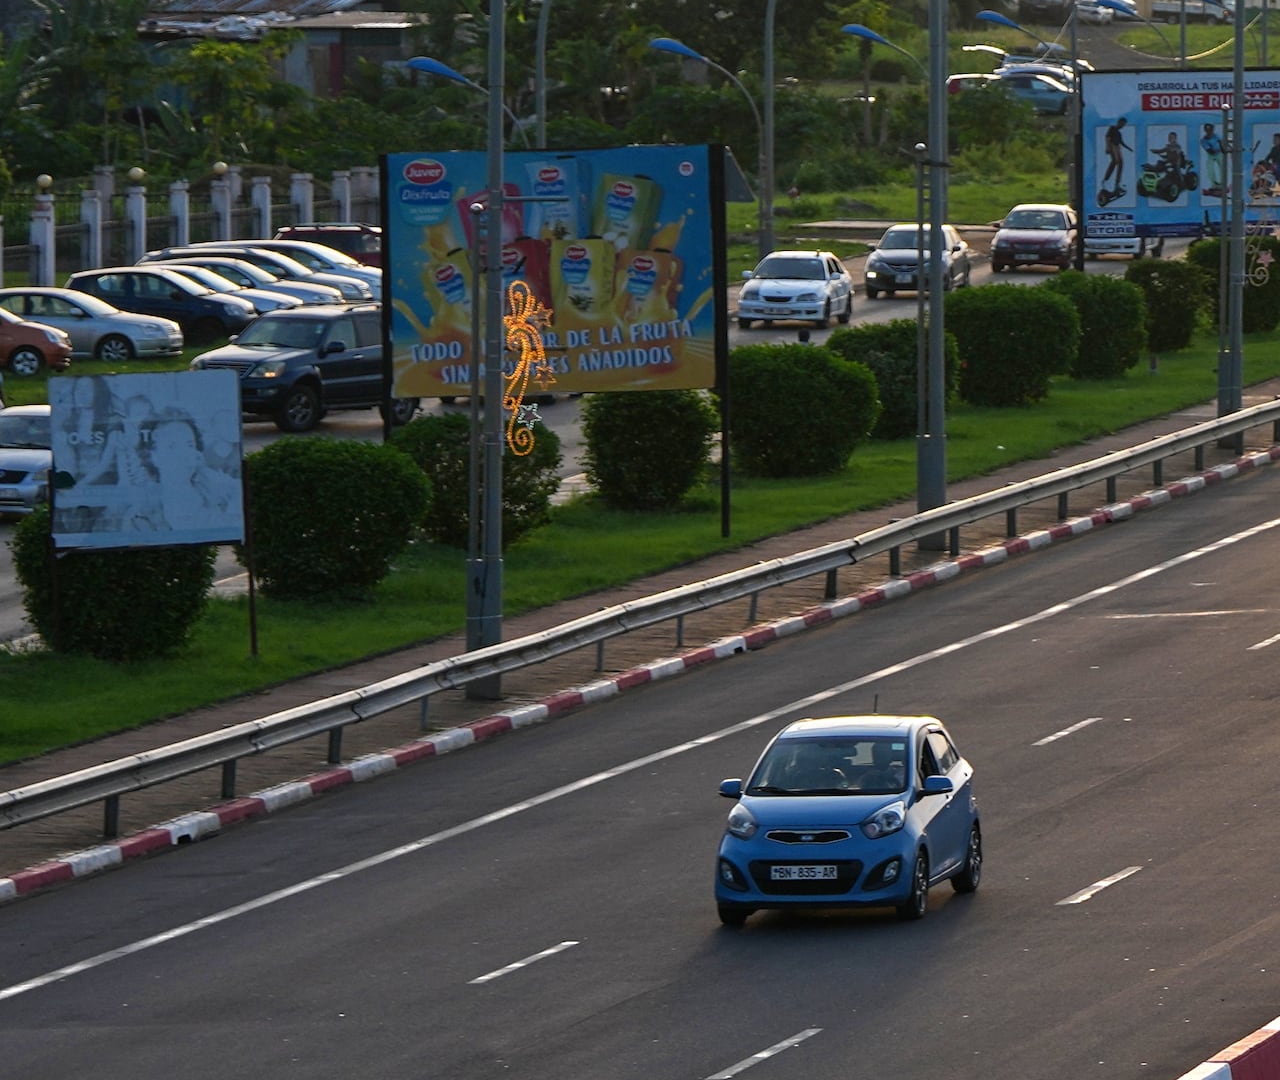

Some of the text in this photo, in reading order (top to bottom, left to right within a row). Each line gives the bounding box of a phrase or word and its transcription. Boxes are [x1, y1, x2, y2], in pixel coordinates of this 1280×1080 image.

[1137, 81, 1199, 91] DESARROLLA
[1201, 81, 1219, 91] TUS
[1149, 94, 1203, 109] SOBRE
[407, 166, 442, 178] Juver
[1087, 226, 1135, 234] STORE
[410, 340, 463, 363] TODO
[568, 328, 590, 350] DE
[600, 323, 622, 345] LA
[630, 318, 694, 342] FRUTA
[441, 363, 471, 385] SIN
[577, 345, 675, 372] AÑADIDOS
